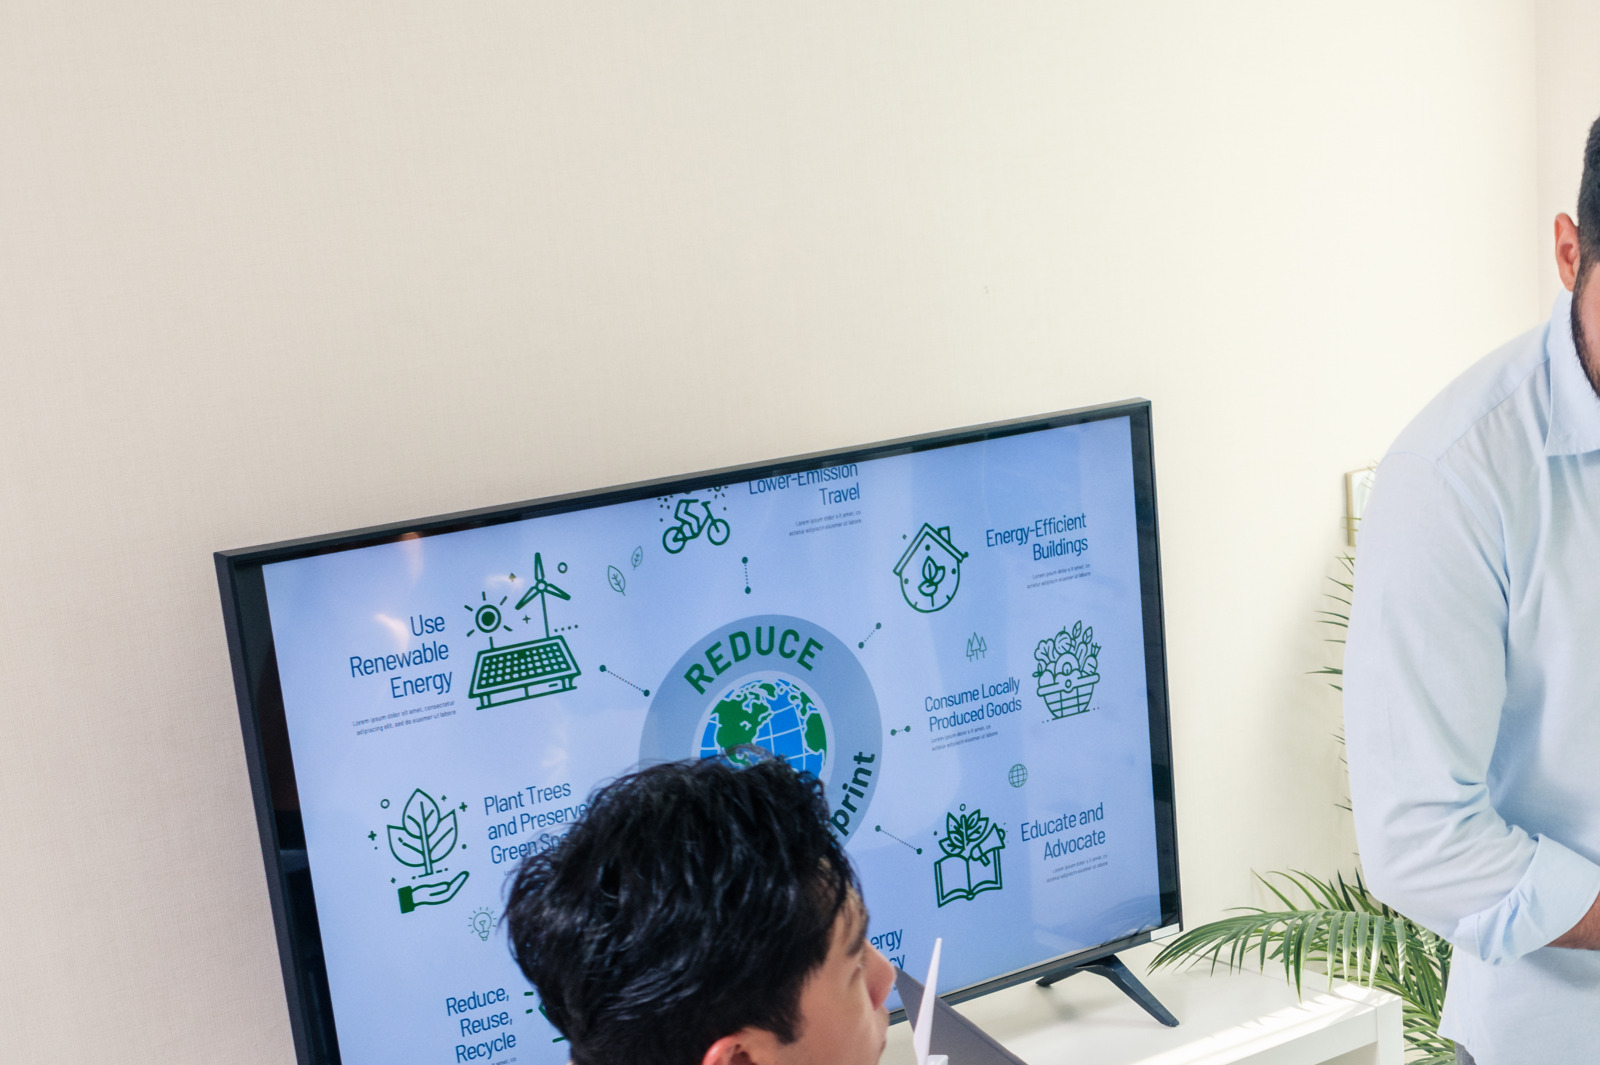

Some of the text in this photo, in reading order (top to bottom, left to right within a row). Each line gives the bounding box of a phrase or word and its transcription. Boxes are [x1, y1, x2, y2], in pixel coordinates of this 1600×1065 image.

[819, 481, 860, 505] Travel
[986, 512, 1087, 547] Energy-Efficient
[1033, 538, 1089, 561] Buildings
[410, 614, 445, 636] Use
[350, 640, 449, 678] Renewable
[683, 626, 824, 695] REDUCE
[390, 671, 452, 698] Energy
[925, 676, 1020, 712] Consume Locally
[929, 697, 1022, 733] Produced Goods
[484, 783, 571, 816] Plant Trees
[830, 751, 875, 837] print
[488, 803, 588, 841] and Preserve
[1021, 801, 1104, 842] Educate and
[491, 840, 537, 864] Green
[1044, 830, 1106, 861] Advocate
[870, 928, 903, 952] ergy
[446, 987, 509, 1016] Reduce,
[460, 1011, 513, 1037] Reuse,
[455, 1032, 516, 1064] Recycle
